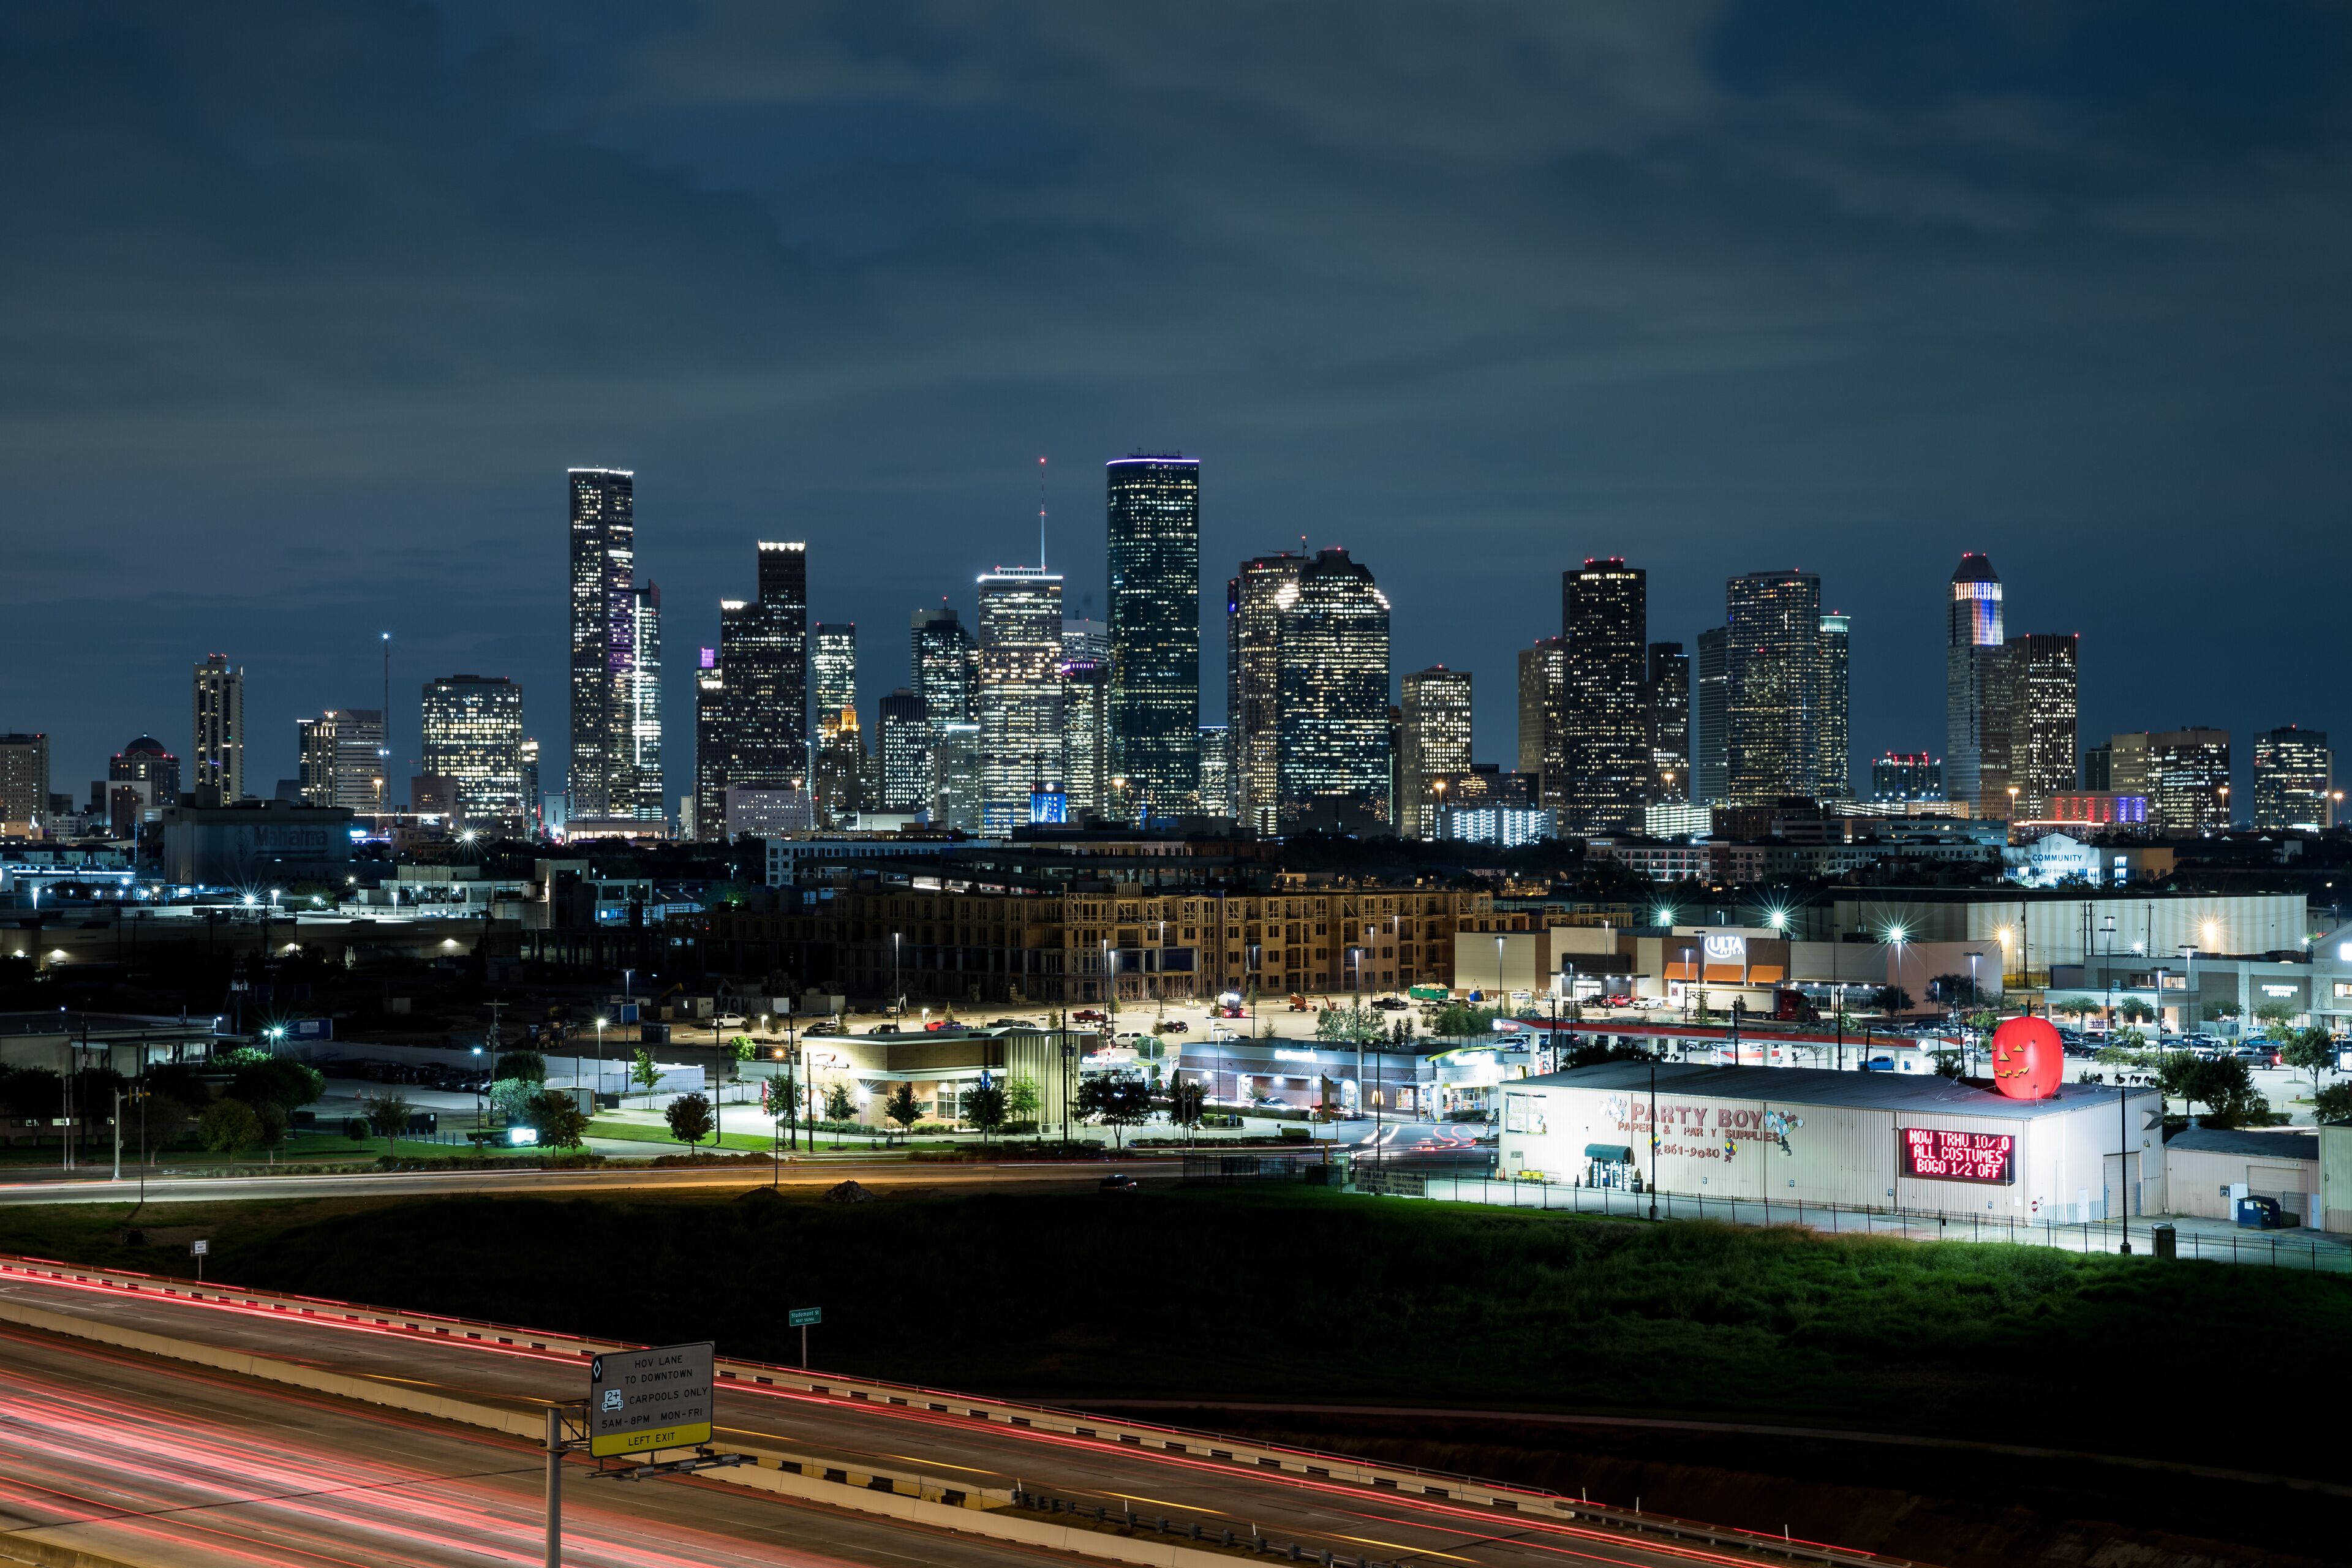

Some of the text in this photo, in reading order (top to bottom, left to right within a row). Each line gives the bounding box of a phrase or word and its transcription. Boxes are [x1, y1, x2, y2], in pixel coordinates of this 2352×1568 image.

[254, 826, 328, 846] Mahatma
[1709, 936, 1744, 951] ULTA
[1632, 1103, 1763, 1129] PARTY BOY
[1618, 1121, 1653, 1133] PAPER
[1663, 1125, 1671, 1134] &
[1725, 1128, 1779, 1142] SUPPLIES
[1909, 1129, 1933, 1145] NOW
[1938, 1131, 1969, 1147] TRHU
[1664, 1144, 1720, 1158] 861-9080
[1913, 1144, 2003, 1164] ALL COSTUMES
[1917, 1158, 2000, 1178] BOGO 1/2 OFF
[635, 1355, 683, 1368] HOV LANE
[625, 1369, 692, 1384] TO DOWNTOWN
[607, 1391, 620, 1402] 2+
[629, 1387, 708, 1404] CARPOOLS ONLY
[628, 1432, 676, 1446] LEFT EXIT
